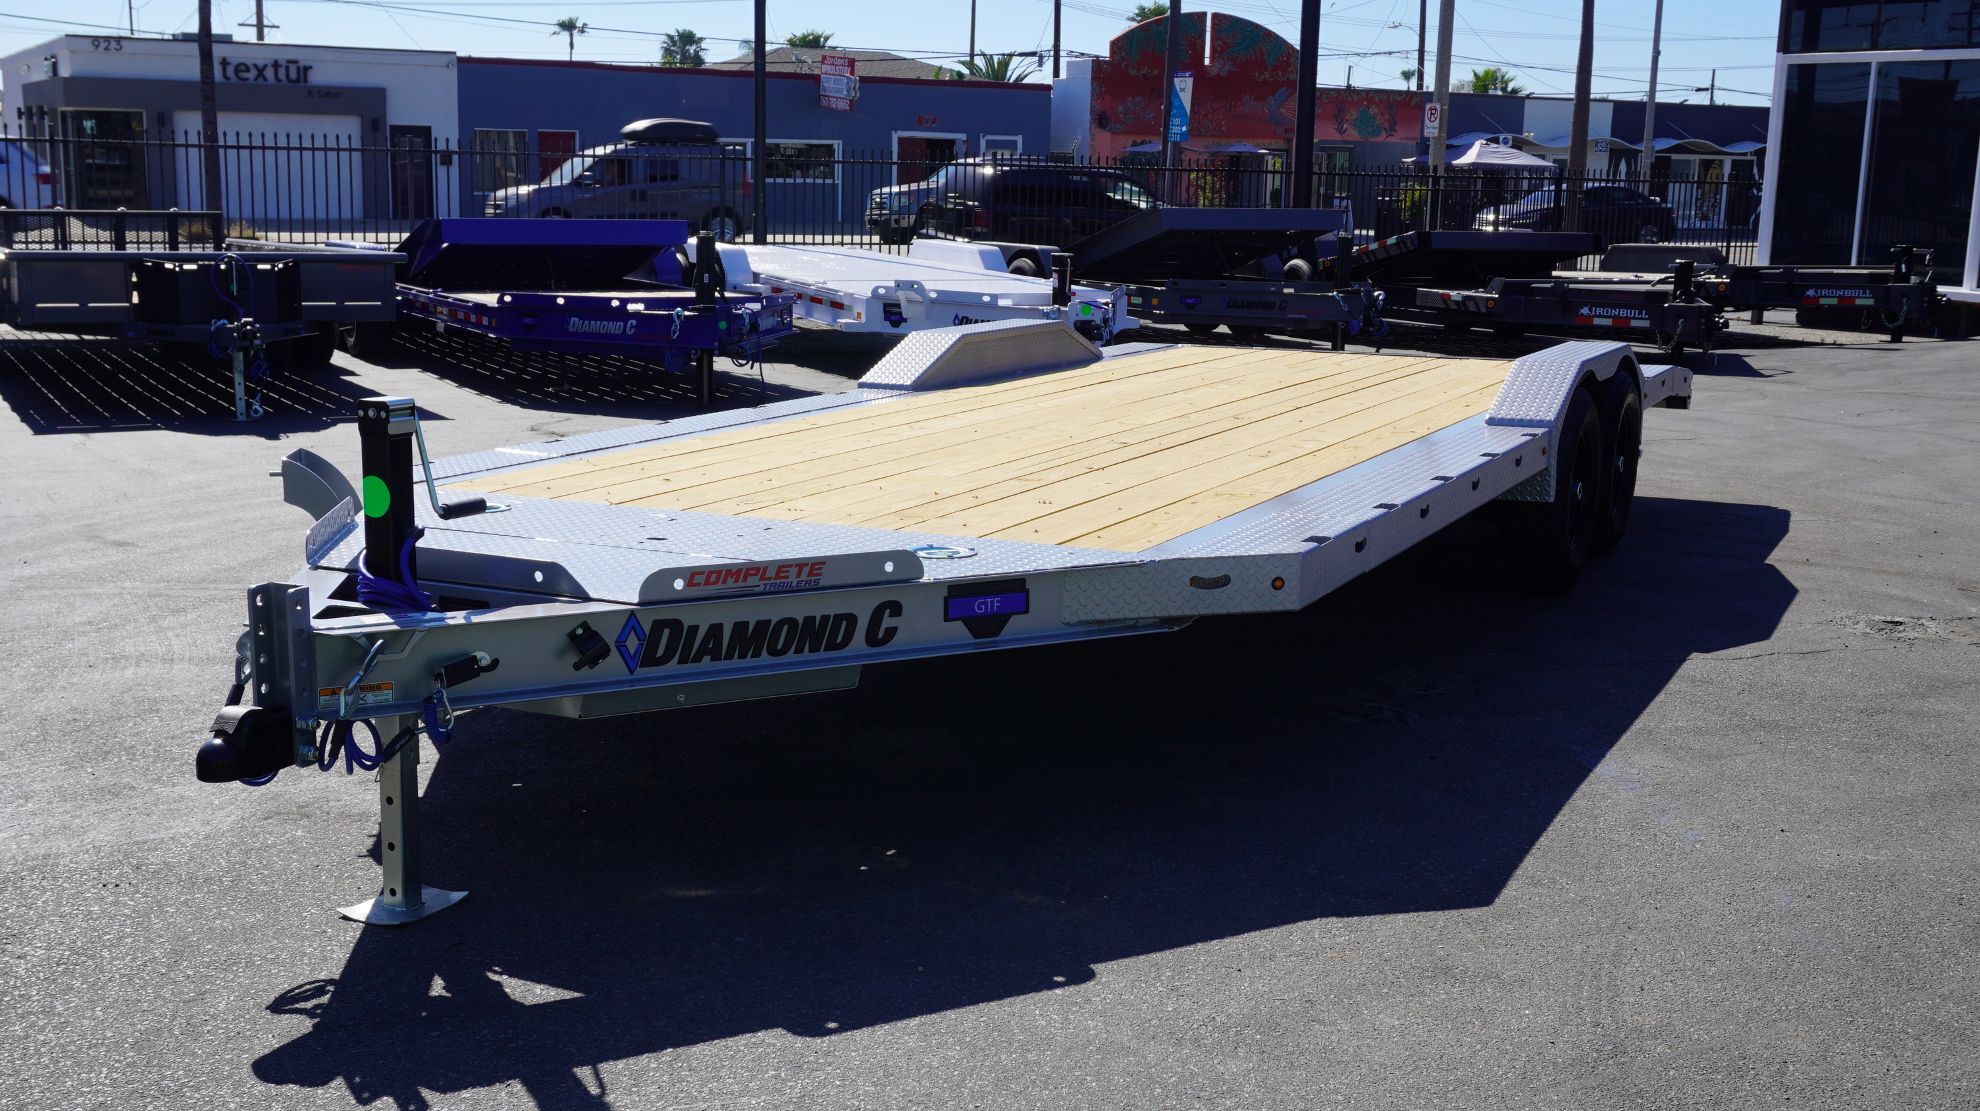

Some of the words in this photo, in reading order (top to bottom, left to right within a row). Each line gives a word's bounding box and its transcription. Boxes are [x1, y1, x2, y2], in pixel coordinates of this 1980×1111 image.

[91, 39, 123, 52] 923
[219, 56, 313, 84] textūr
[317, 89, 342, 99] Salon
[1817, 288, 1873, 298] IRONBULL
[1591, 306, 1649, 319] IRONBULL
[568, 317, 623, 334] DIAMOND
[625, 319, 637, 335] C
[686, 561, 827, 588] COMPLETE
[760, 578, 821, 592] TRAILERS
[974, 597, 1001, 614] GTF
[638, 611, 858, 669] DIAMOND
[865, 600, 904, 648] C
